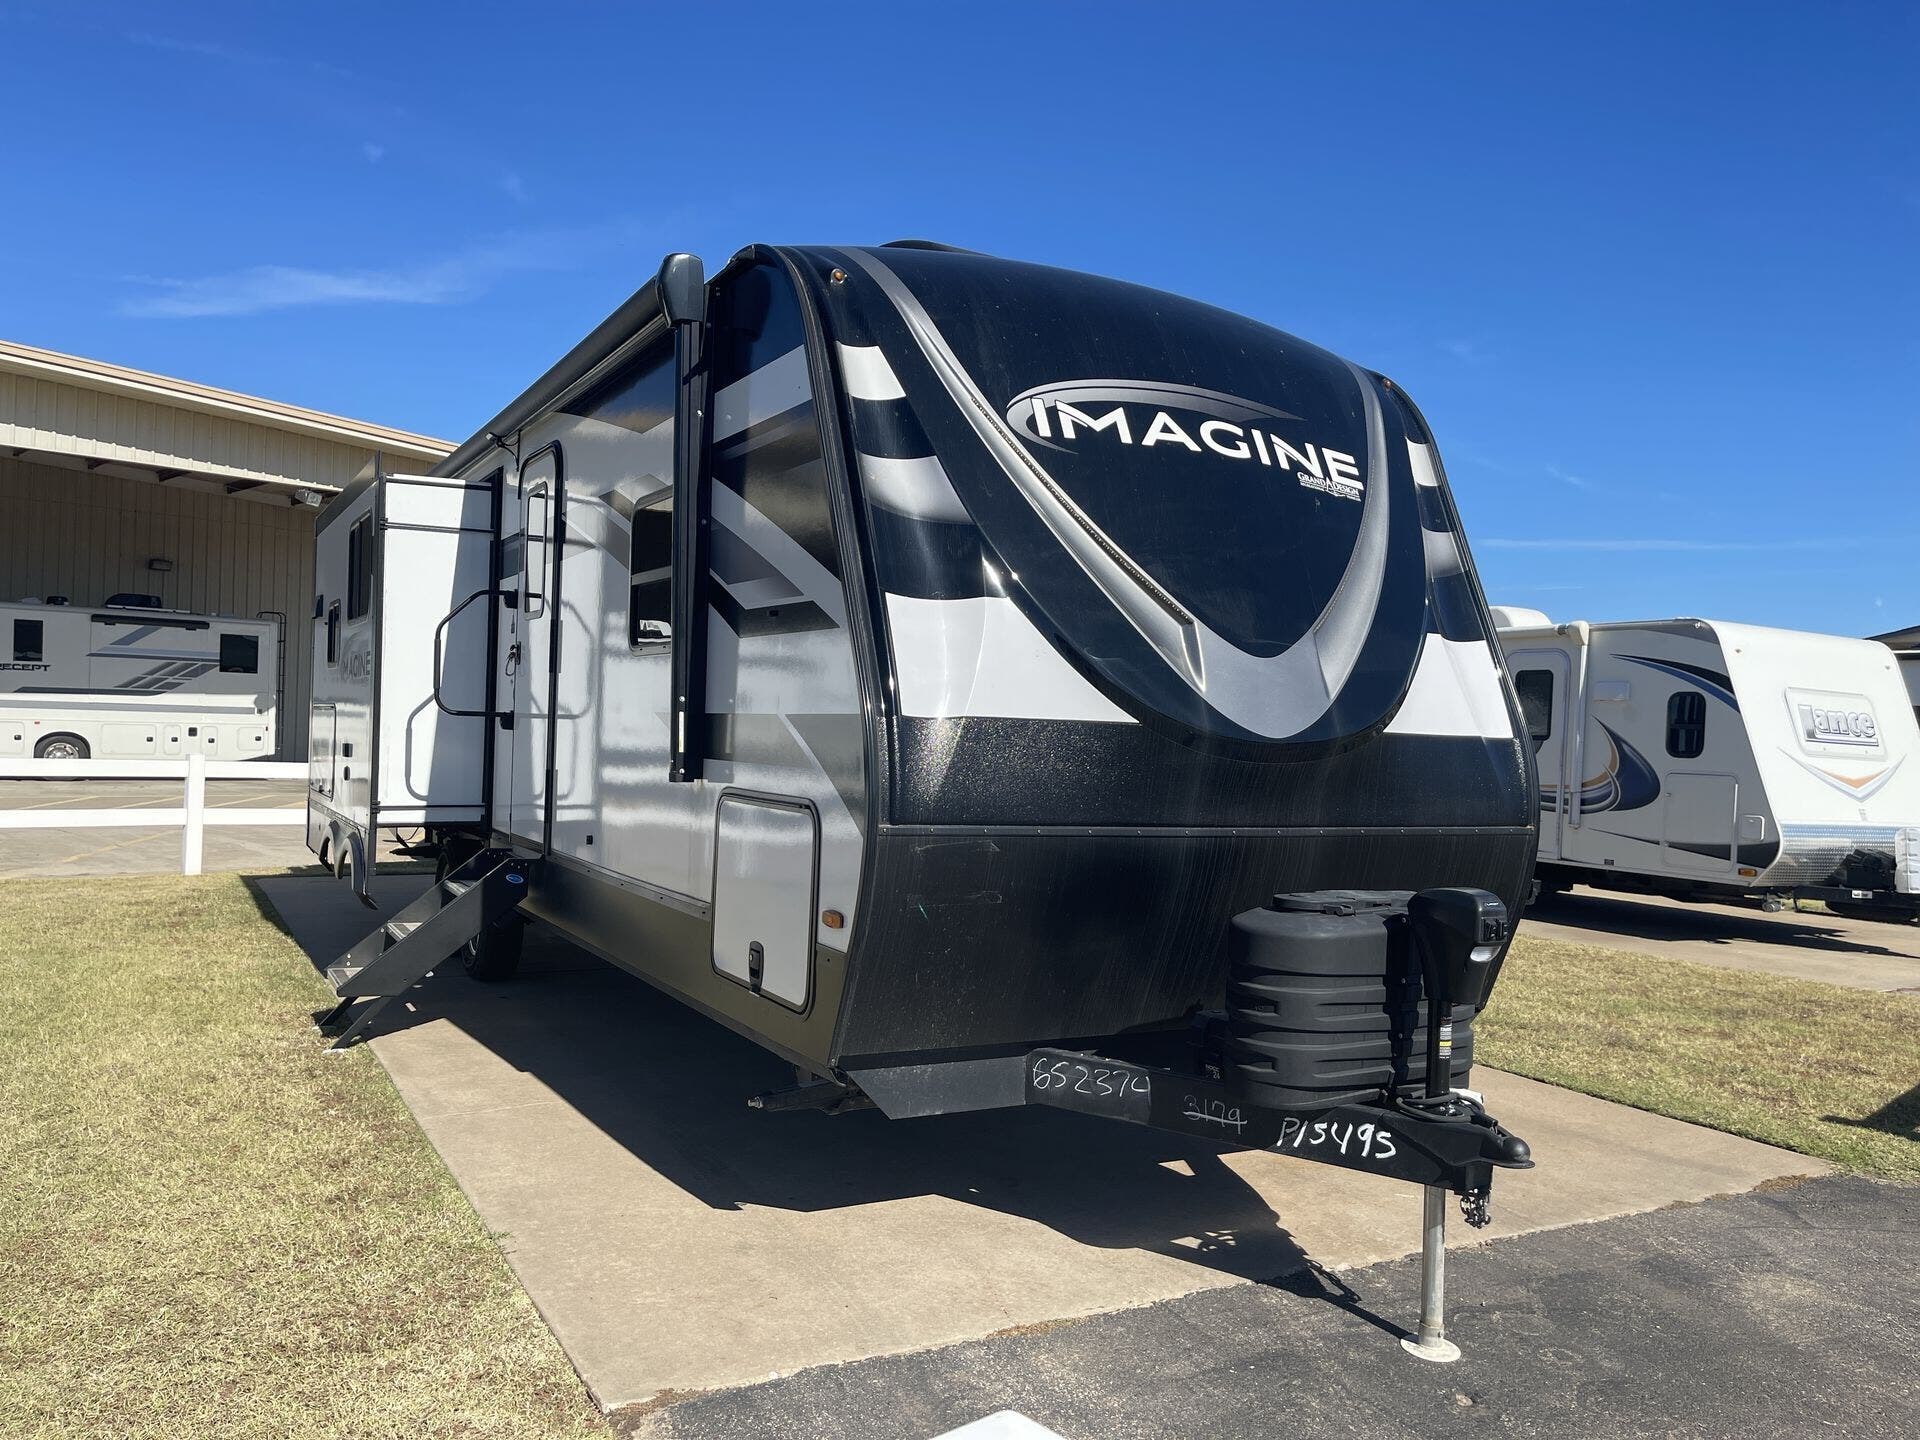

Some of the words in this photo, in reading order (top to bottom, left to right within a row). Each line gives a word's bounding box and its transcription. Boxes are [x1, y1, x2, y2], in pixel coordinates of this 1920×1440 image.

[1030, 398, 1365, 490] IMAGINE
[1297, 472, 1326, 486] GRAND
[1798, 704, 1879, 747] Lance
[1276, 1117, 1397, 1159] P15495
